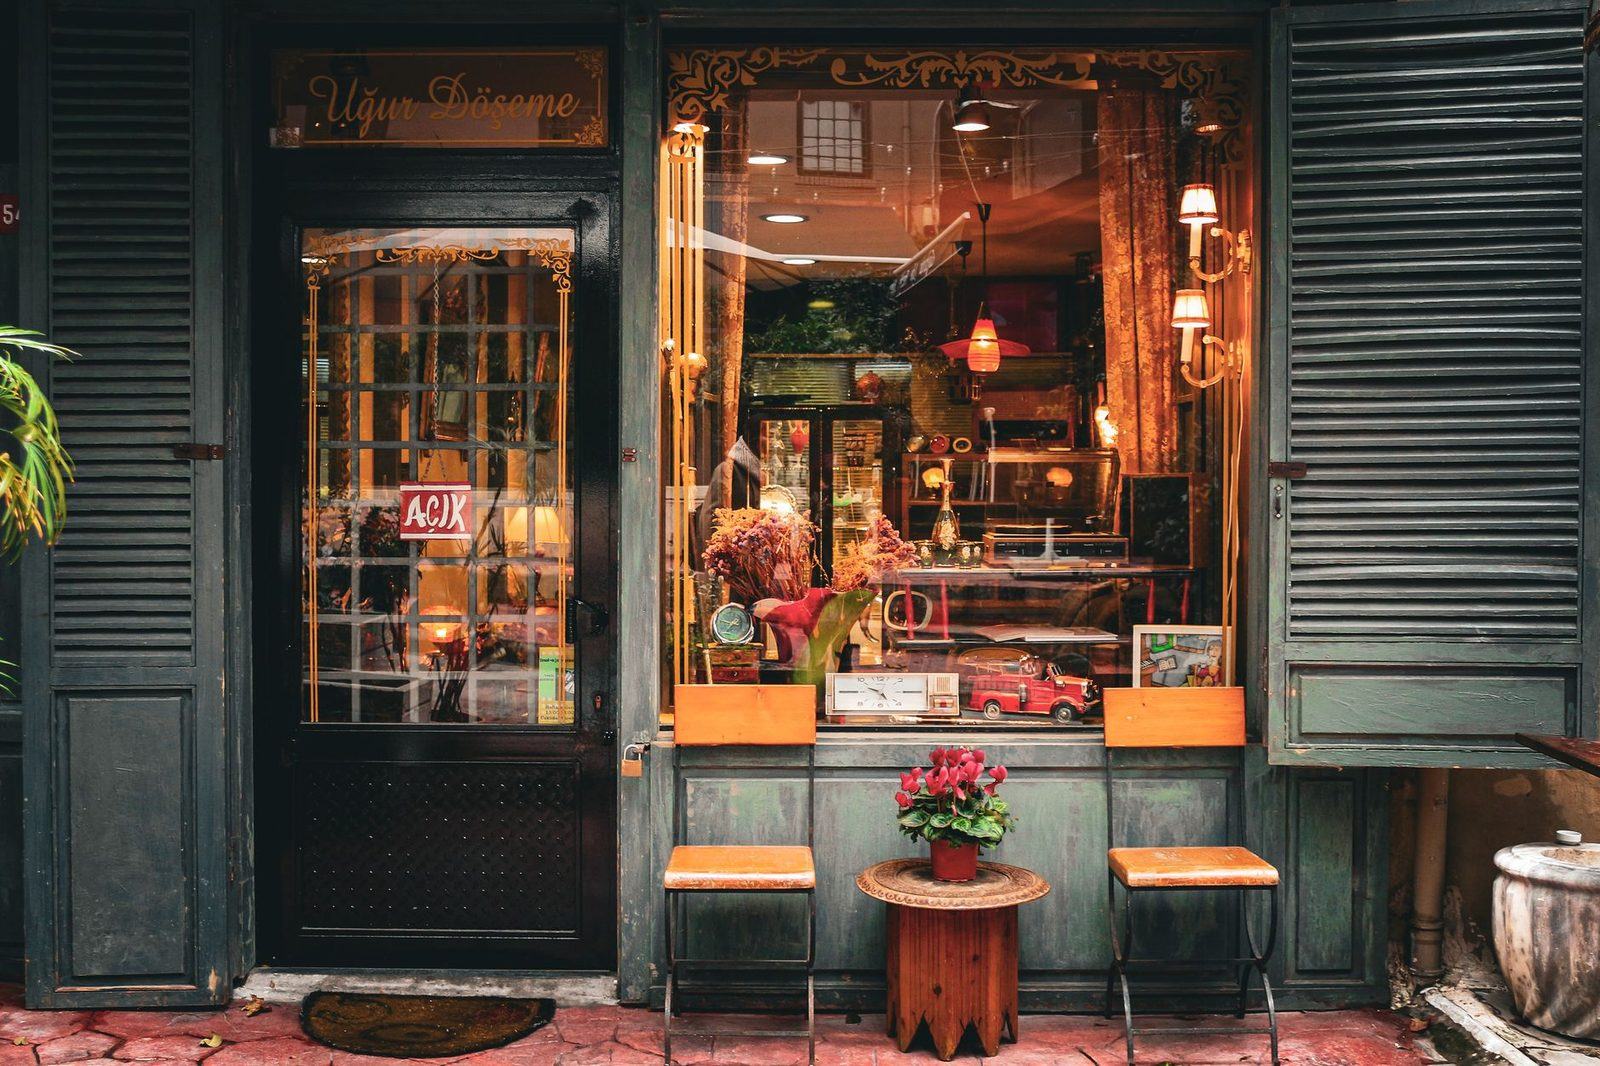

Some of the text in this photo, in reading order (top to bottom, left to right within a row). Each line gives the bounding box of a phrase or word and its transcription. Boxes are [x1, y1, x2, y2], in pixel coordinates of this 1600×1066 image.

[308, 72, 582, 139] Uğur Döşeme
[403, 493, 467, 533] AÇIK
